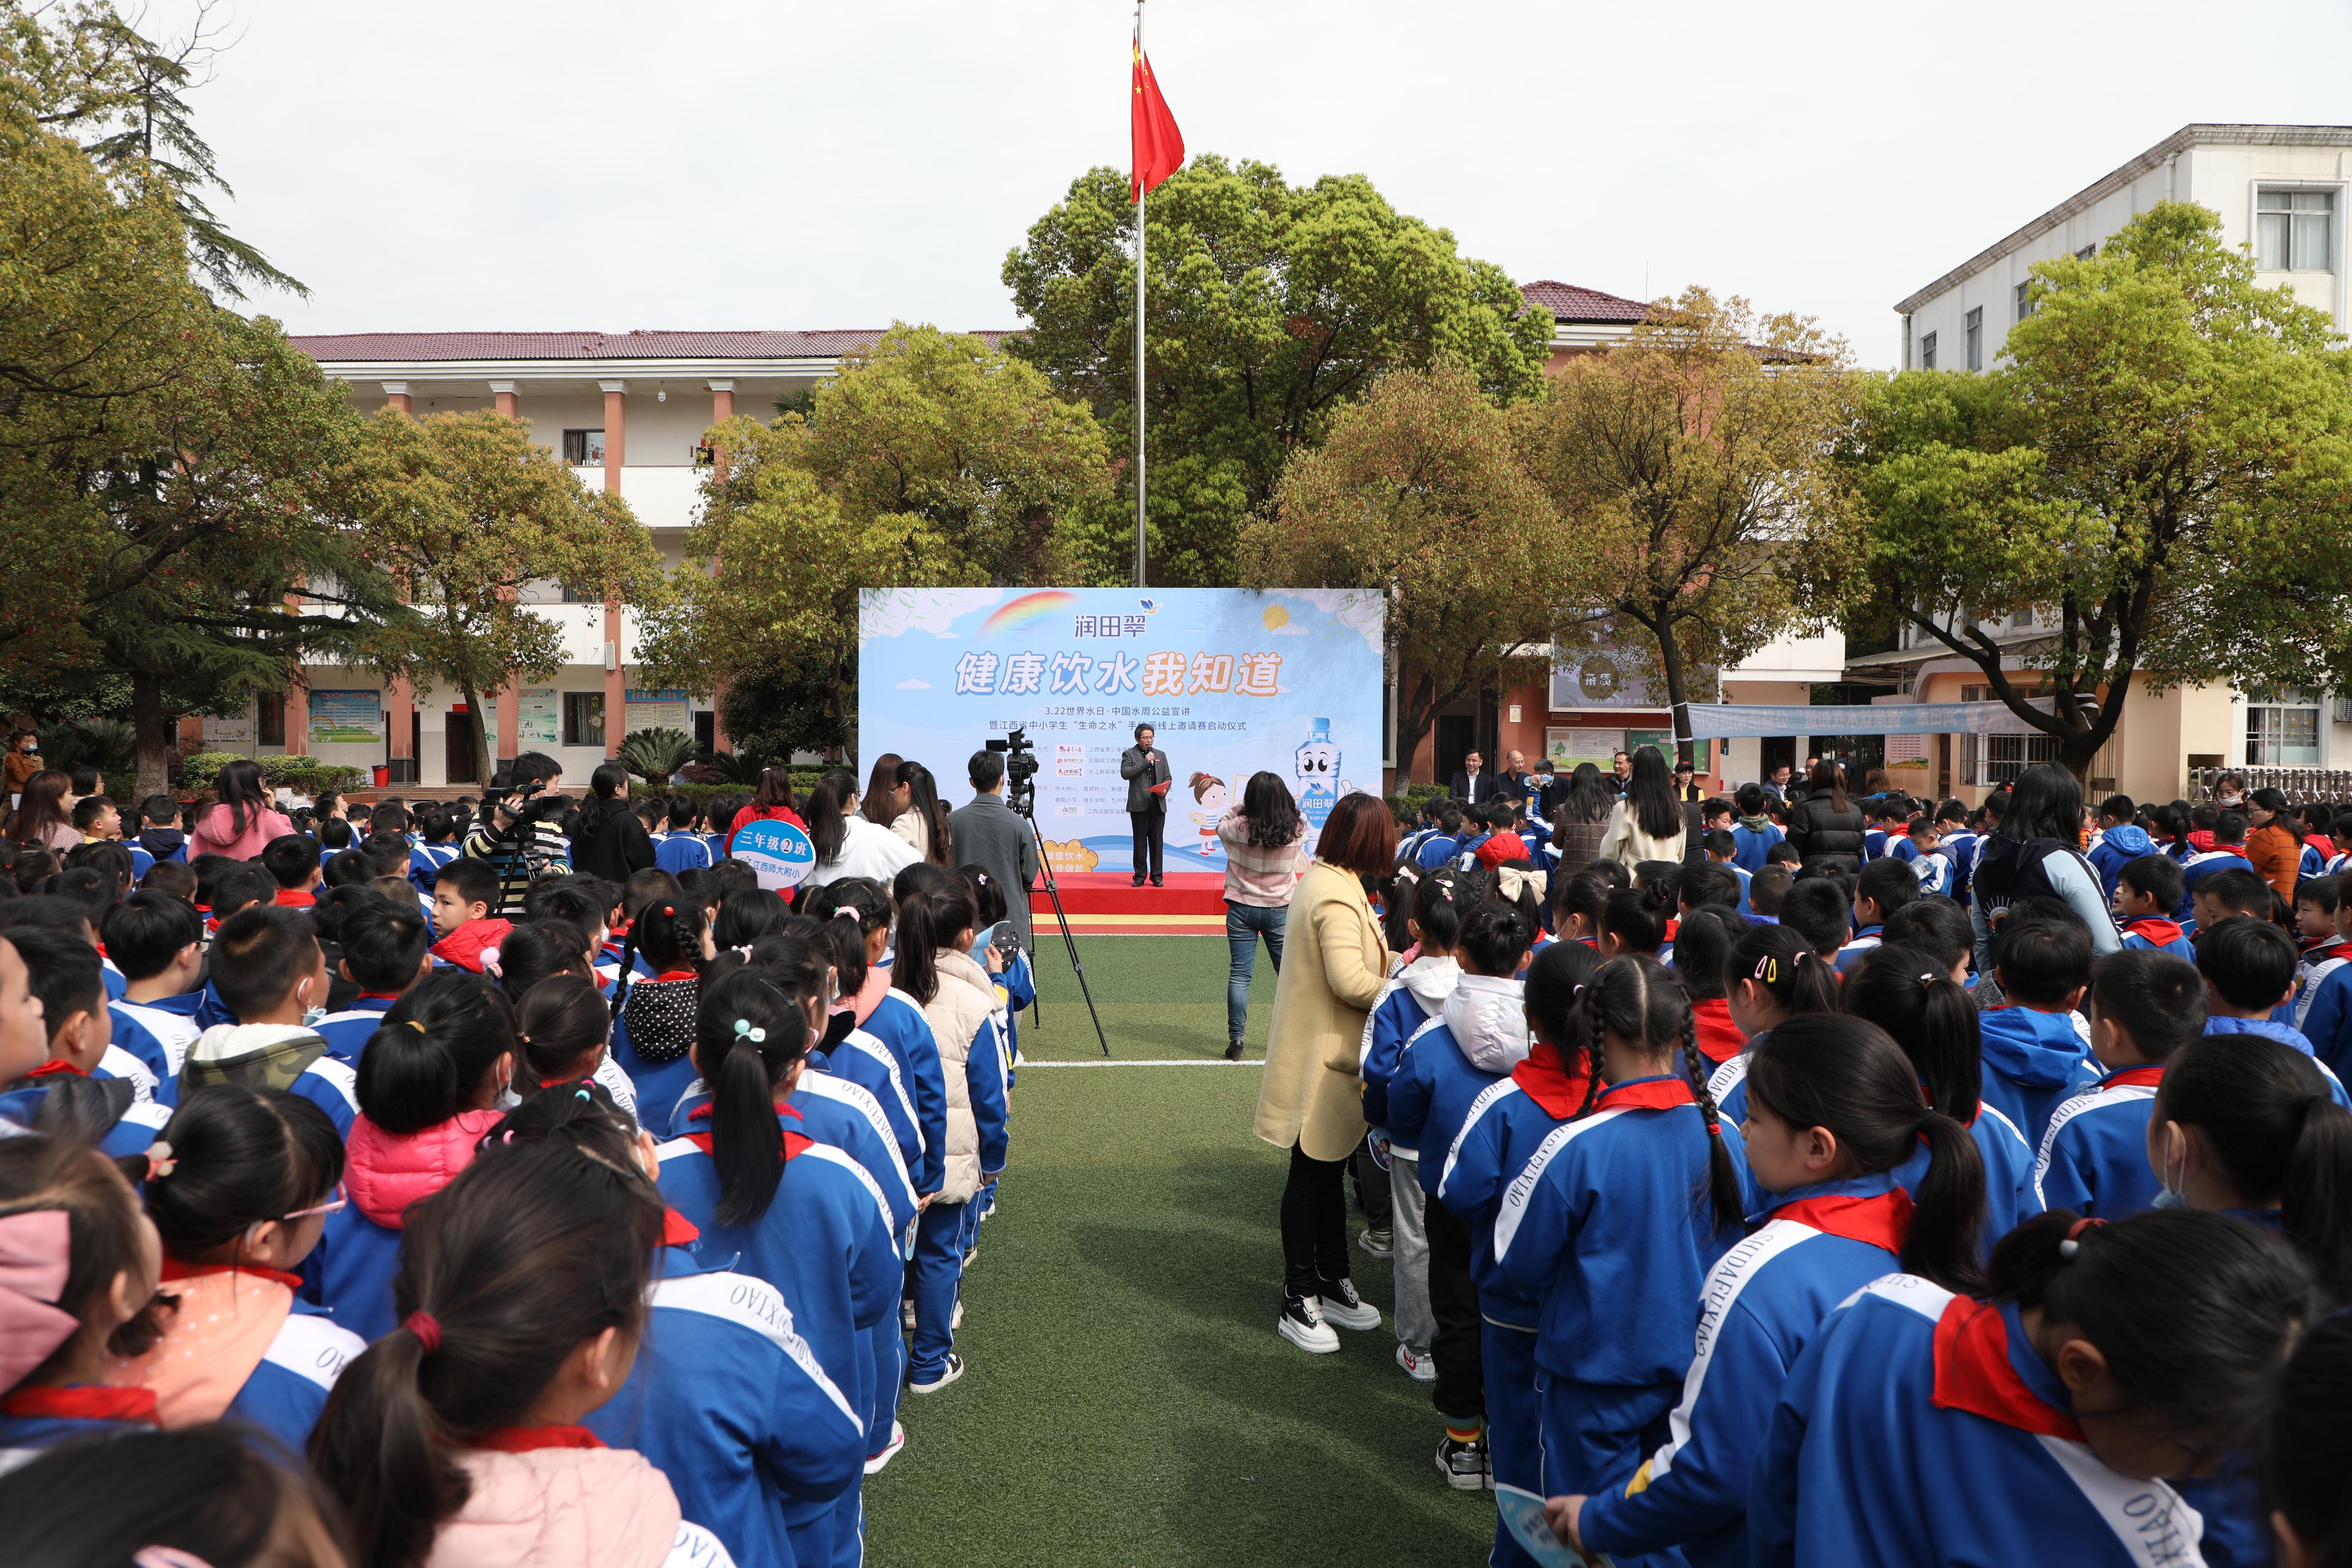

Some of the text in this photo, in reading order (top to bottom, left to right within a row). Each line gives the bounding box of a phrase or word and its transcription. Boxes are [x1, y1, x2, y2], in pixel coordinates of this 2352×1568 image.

[1075, 615, 1147, 638] 润田翠
[956, 651, 1284, 696] 健康饮水我知道
[1045, 707, 1190, 716] 3.22世界水日·中国水周公益宣讲
[1302, 799, 1334, 809] 润田翠
[753, 860, 800, 878] 江西师大附小
